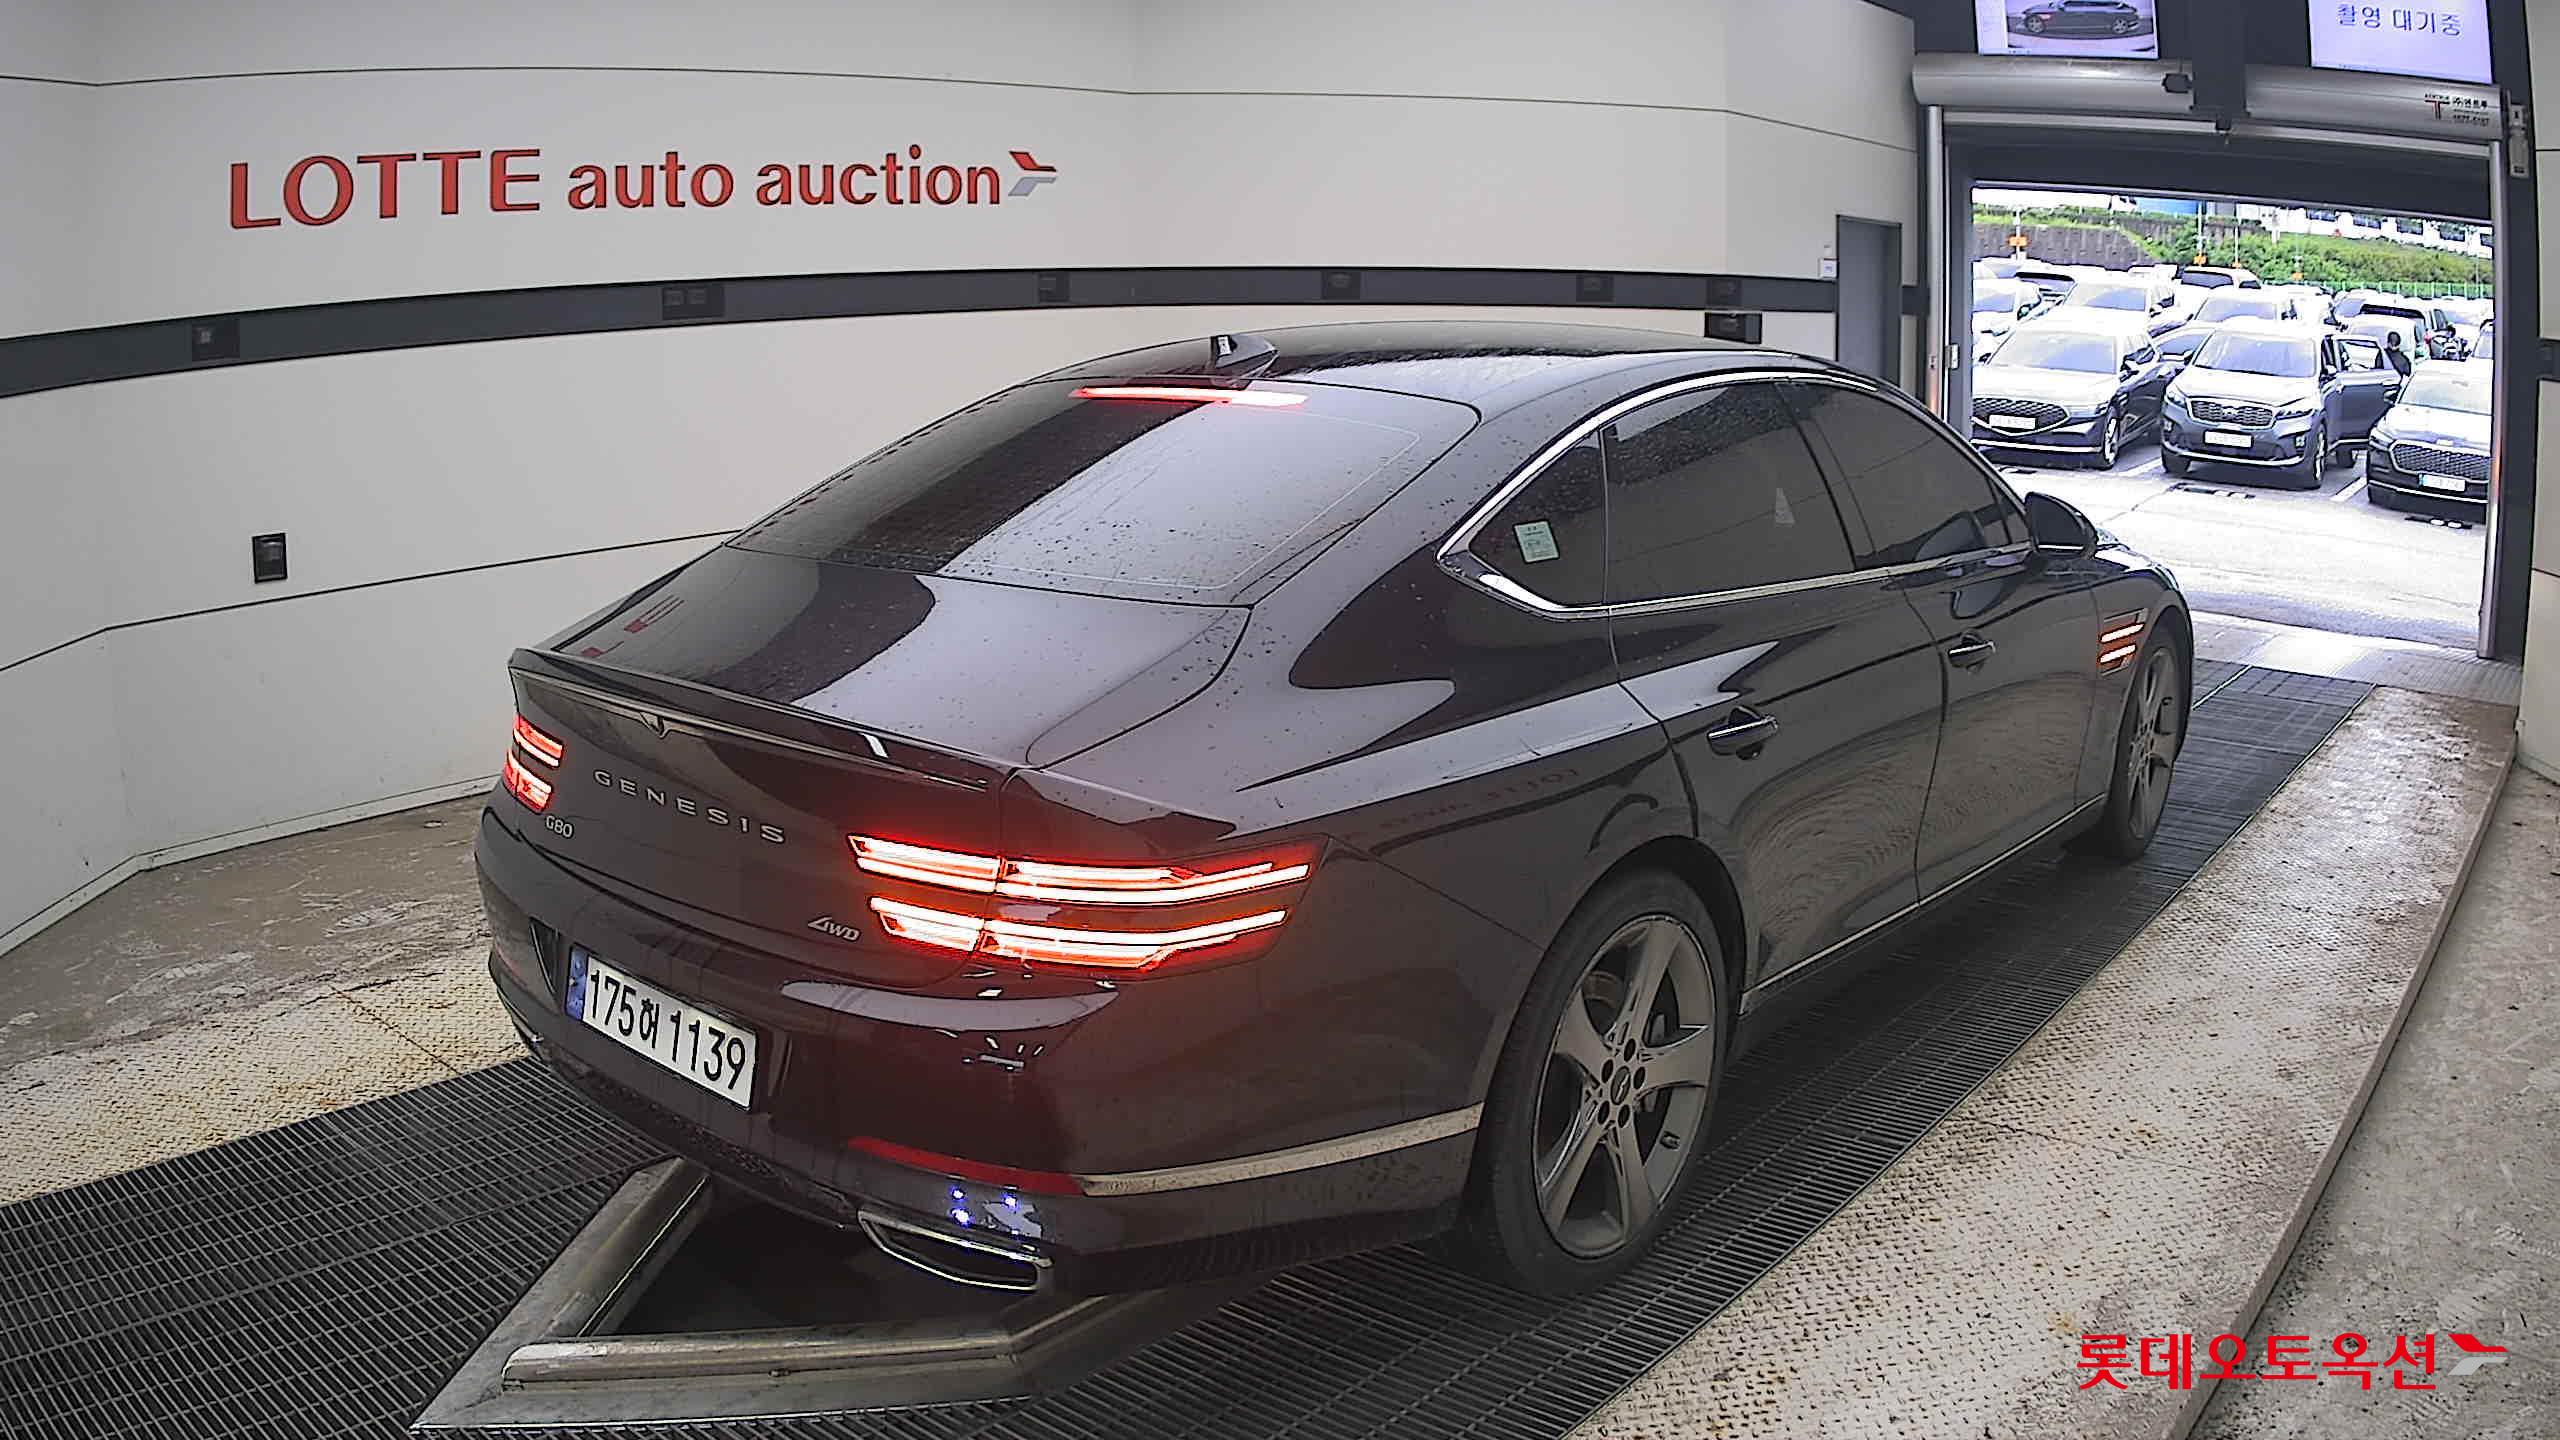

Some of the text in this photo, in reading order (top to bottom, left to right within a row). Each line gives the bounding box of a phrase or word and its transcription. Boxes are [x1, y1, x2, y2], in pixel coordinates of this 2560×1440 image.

[2338, 4, 2461, 37] 촬영 대기중
[229, 144, 1001, 230] LOTTE auto auction
[545, 814, 575, 839] G80
[592, 769, 786, 844] GENESIS
[807, 916, 861, 943] 4WD
[590, 969, 747, 1091] 175허 1139
